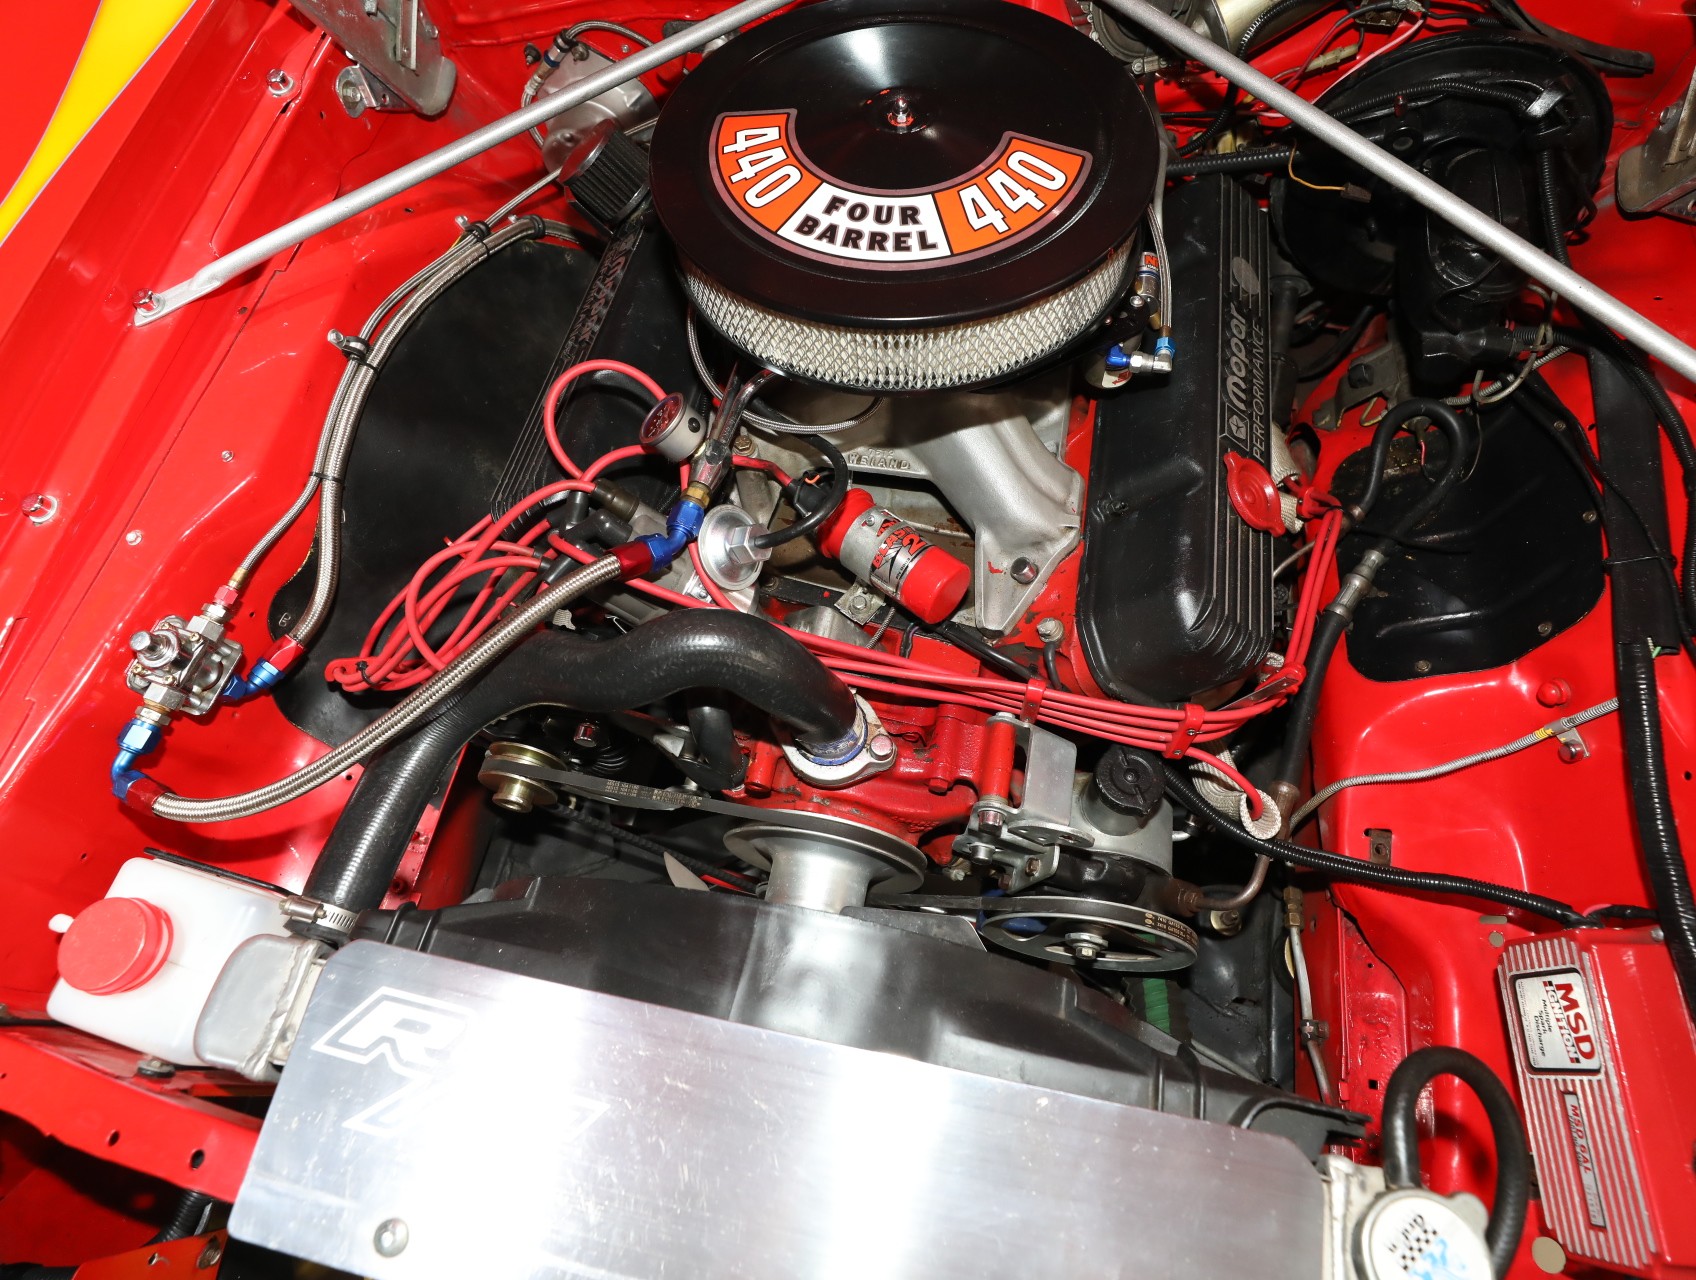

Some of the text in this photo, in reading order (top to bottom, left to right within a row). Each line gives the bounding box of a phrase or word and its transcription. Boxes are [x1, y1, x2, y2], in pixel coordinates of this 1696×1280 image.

[722, 125, 803, 208] 440
[822, 195, 921, 226] FOUR
[957, 150, 1068, 235] 440
[794, 213, 939, 253] BARREL
[1252, 320, 1265, 464] PERFORMANCE
[901, 533, 927, 556] 2
[1534, 1015, 1546, 1057] Discharge
[1538, 1010, 1547, 1034] Spark
[1542, 999, 1552, 1033] Multiple
[1545, 985, 1579, 1059] IGNITION
[1555, 983, 1596, 1060] MSD
